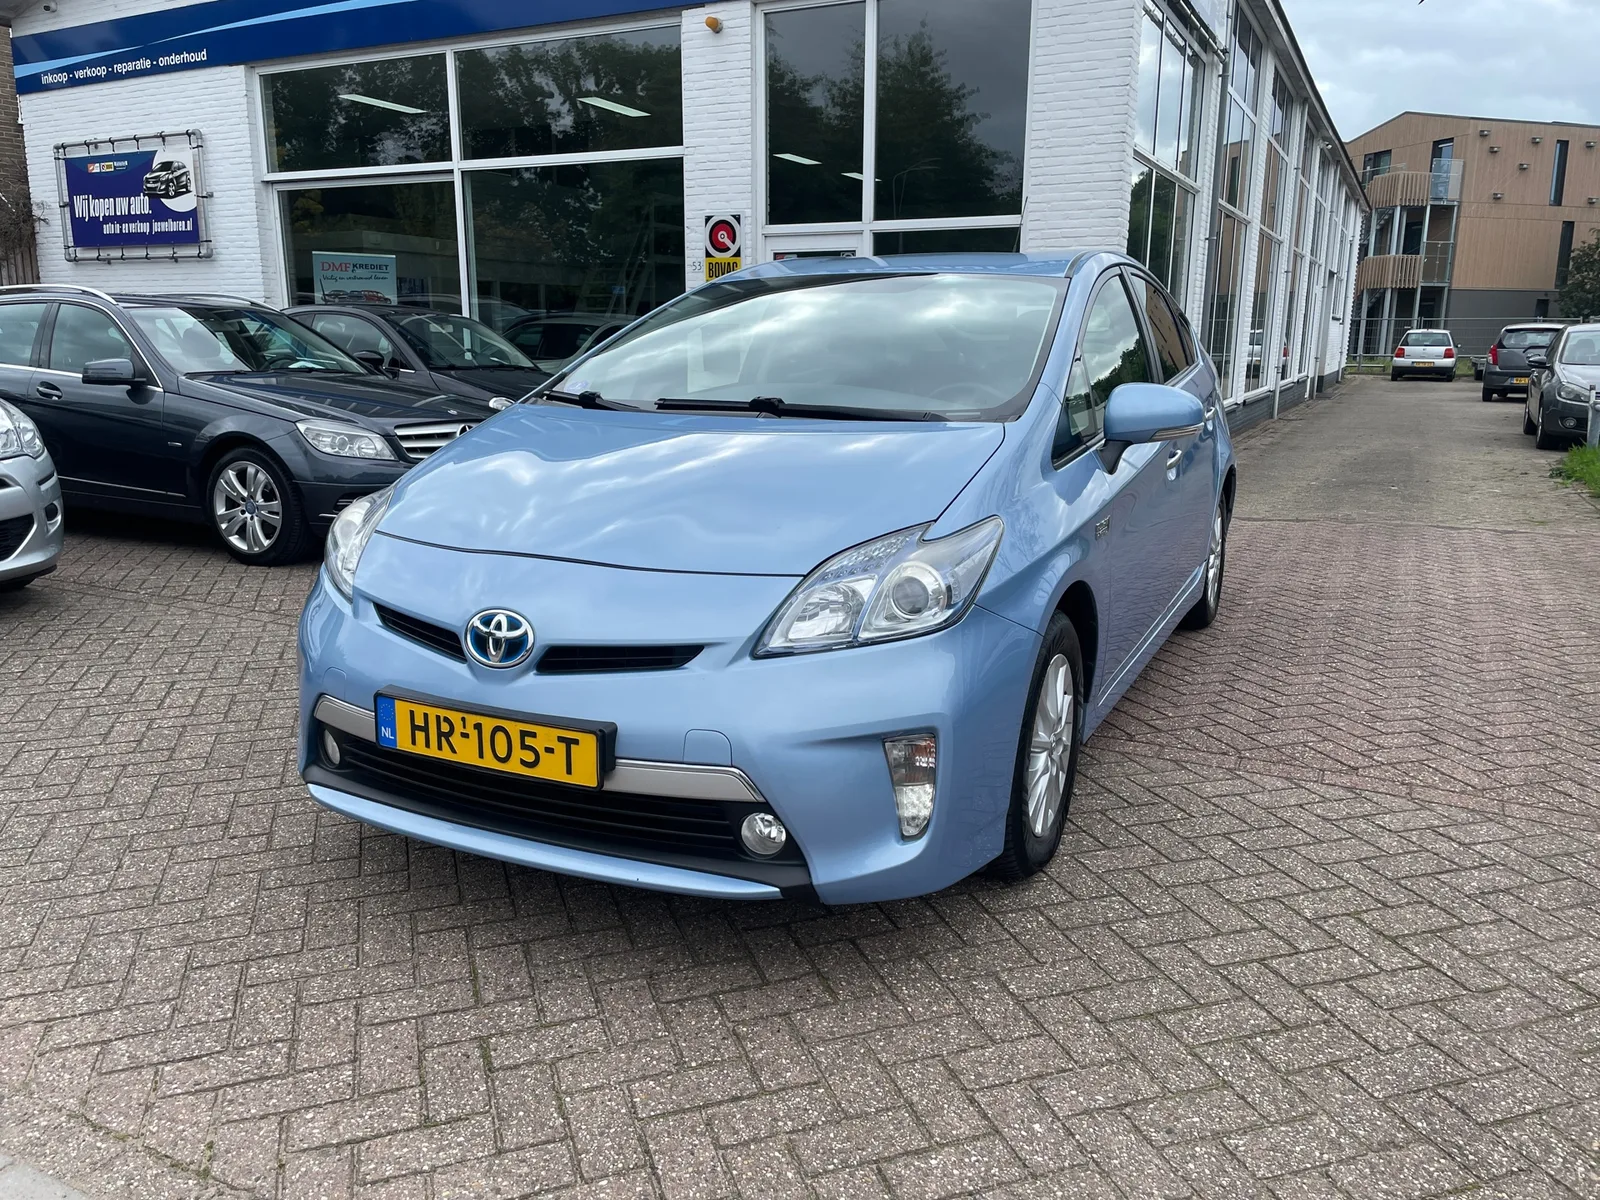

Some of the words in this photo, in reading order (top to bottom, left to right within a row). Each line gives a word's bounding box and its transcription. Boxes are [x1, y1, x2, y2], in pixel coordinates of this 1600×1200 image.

[41, 73, 68, 84] inkoop
[74, 66, 107, 79] verkoop
[113, 59, 151, 74] reparatie
[158, 49, 207, 67] onderhoud
[73, 194, 89, 222] Wij
[89, 194, 115, 221] kopen
[115, 197, 129, 215] uw
[130, 192, 152, 215] auto.
[122, 223, 129, 234] en
[129, 220, 150, 235] verkoop
[320, 261, 351, 272] DMF
[352, 262, 389, 271] KREDIET
[692, 261, 702, 271] 53
[381, 725, 395, 740] NL
[408, 709, 580, 776] HR-105-T
